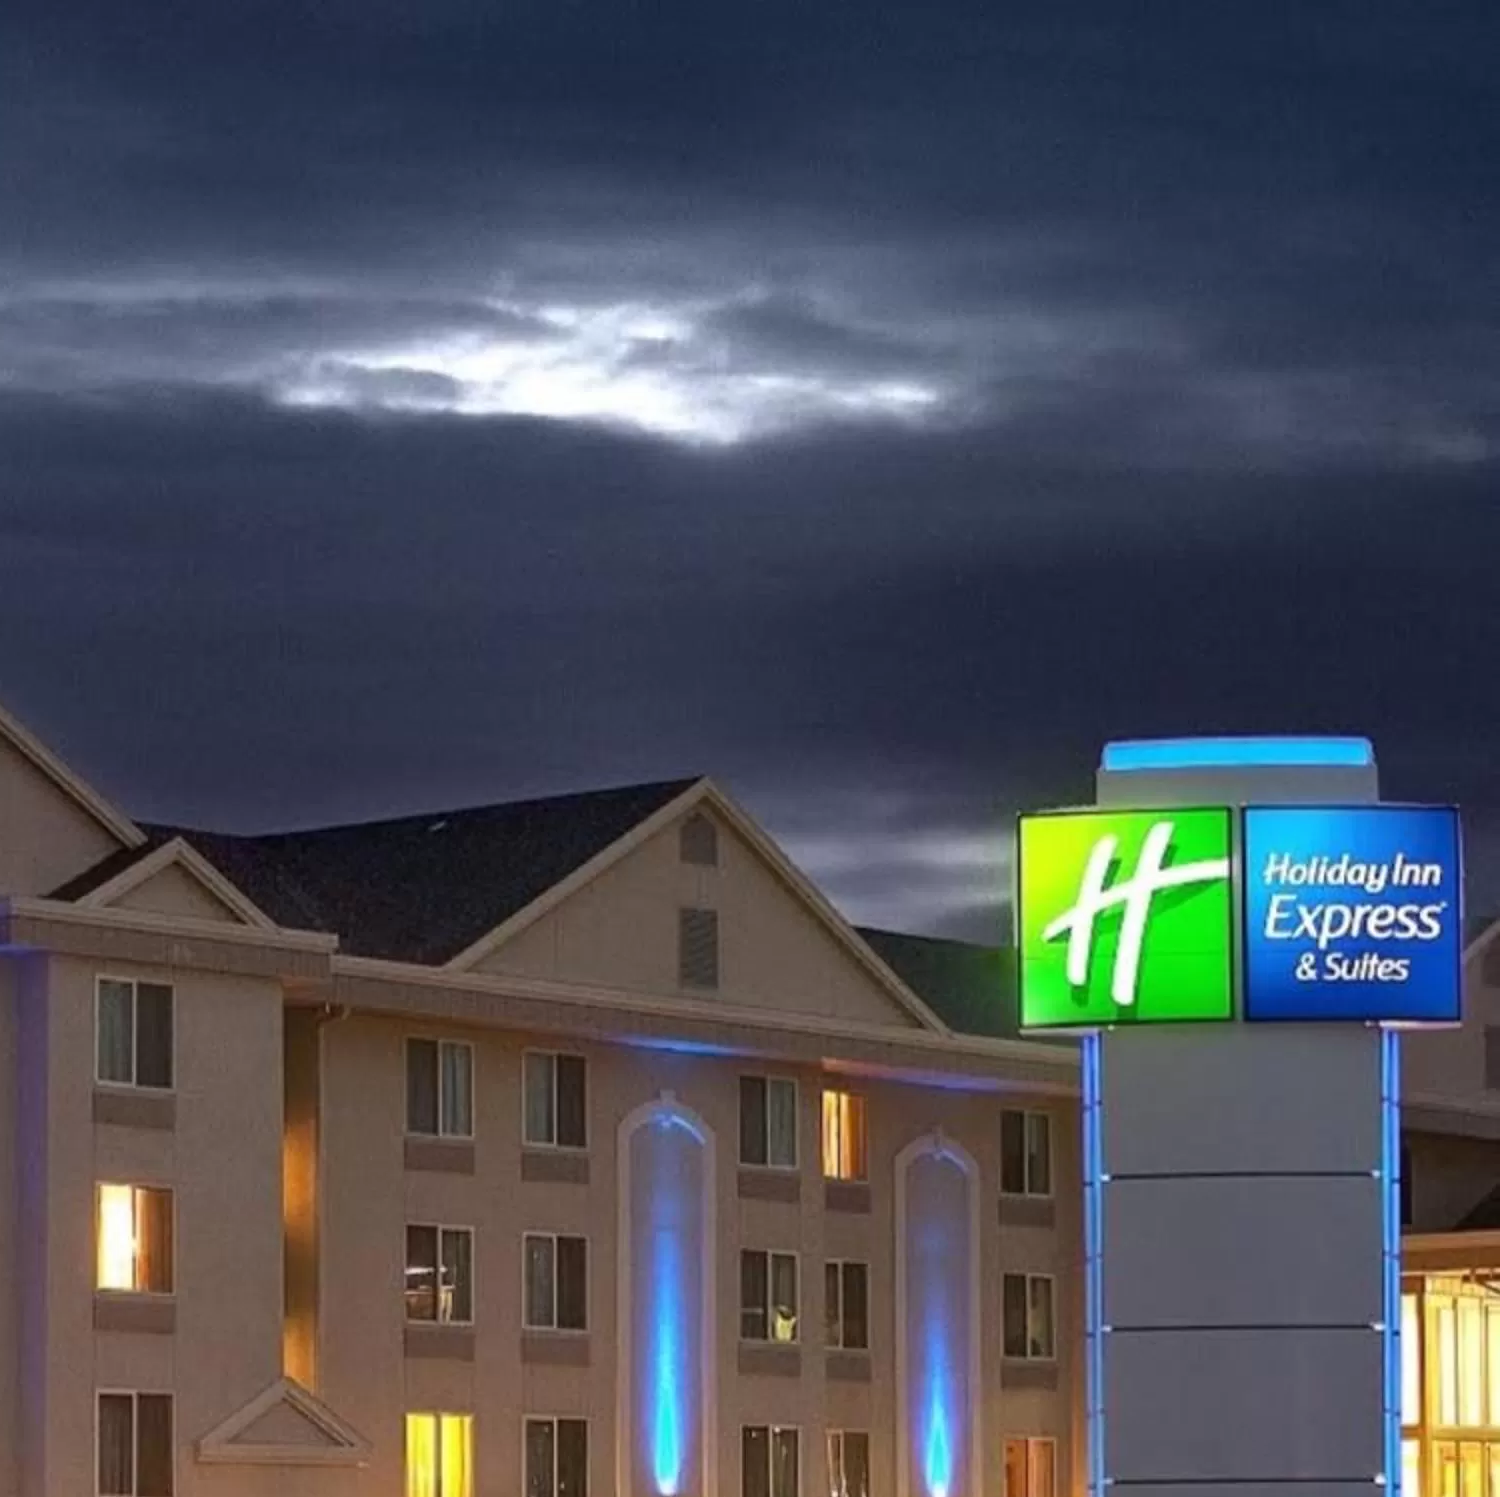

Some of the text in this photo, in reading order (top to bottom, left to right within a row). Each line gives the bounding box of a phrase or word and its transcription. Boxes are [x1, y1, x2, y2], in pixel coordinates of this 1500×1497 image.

[1263, 852, 1441, 893] Holiday Inn
[1264, 894, 1442, 949] Express
[1295, 952, 1410, 980] & Suites
